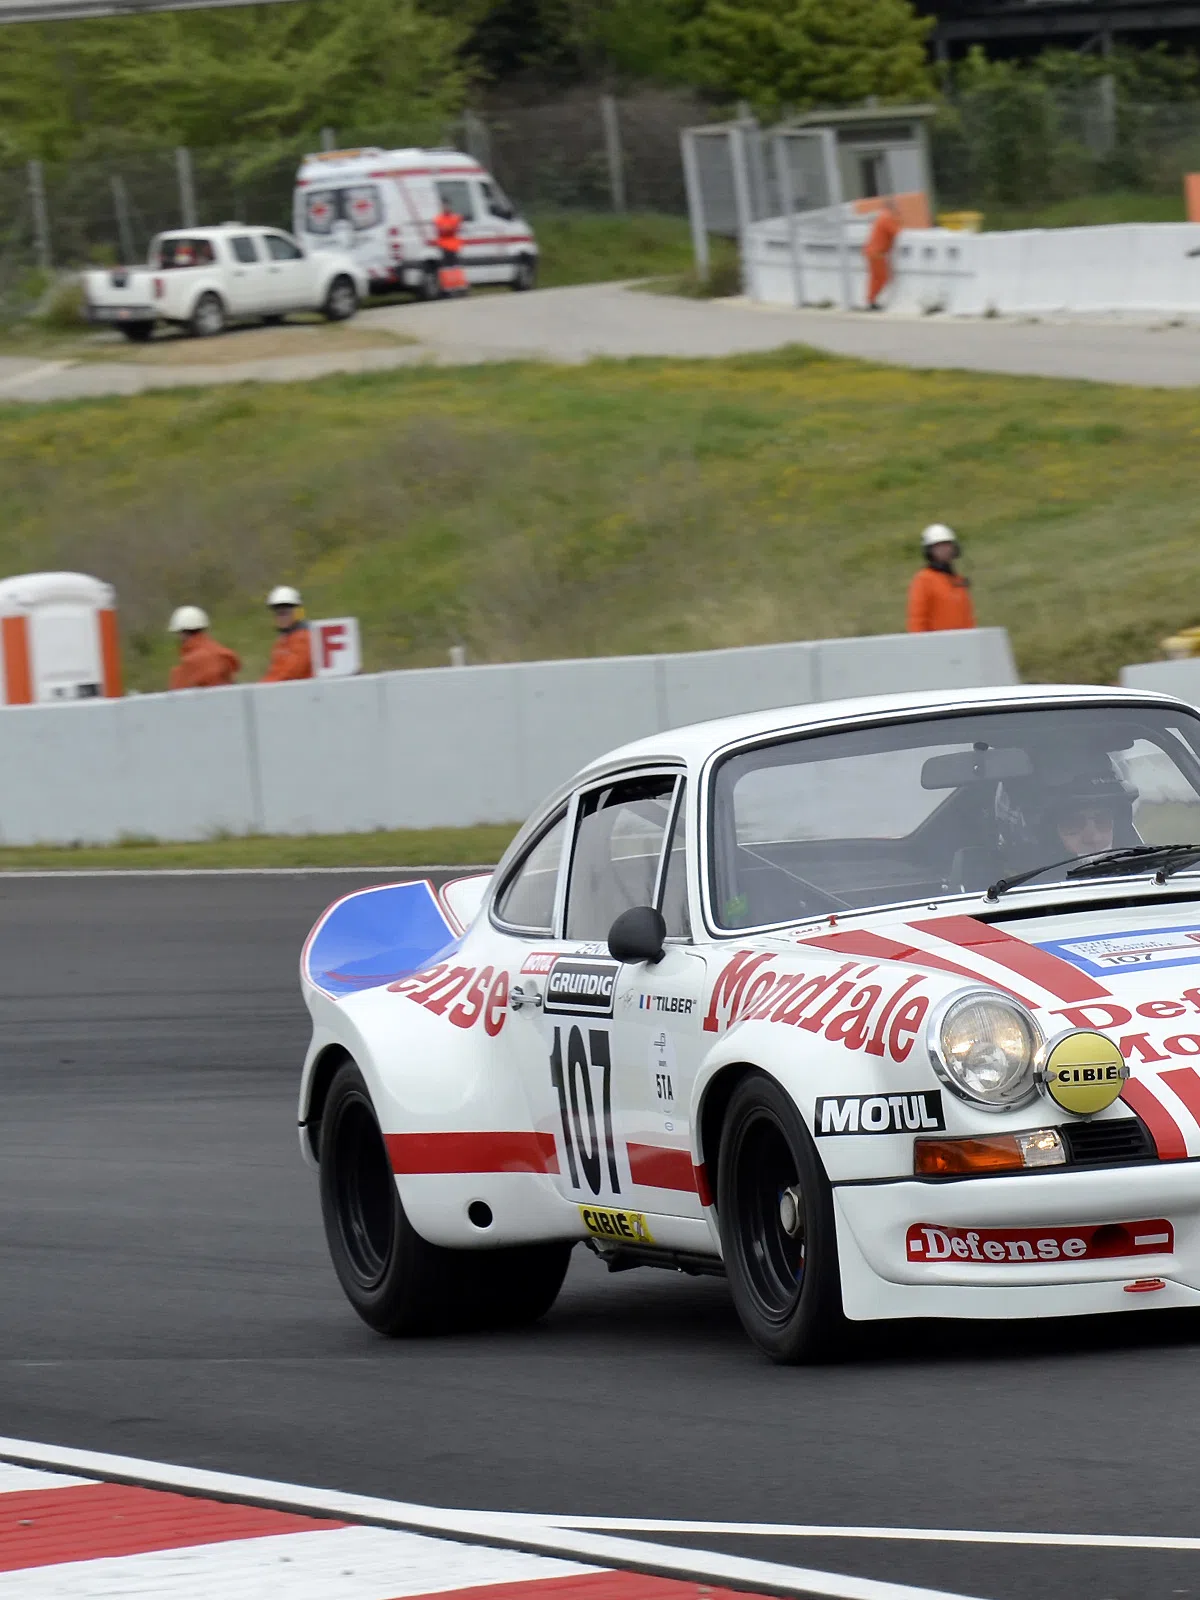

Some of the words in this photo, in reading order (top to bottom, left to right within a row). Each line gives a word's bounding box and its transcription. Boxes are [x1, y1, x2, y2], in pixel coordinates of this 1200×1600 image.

[321, 625, 347, 669] F
[1101, 952, 1153, 965] 107
[550, 973, 614, 996] GRUNDIG
[703, 950, 929, 1062] Mondiale
[549, 1024, 622, 1196] 107
[820, 1094, 938, 1133] MOTUL
[920, 1228, 1088, 1260] Defense
